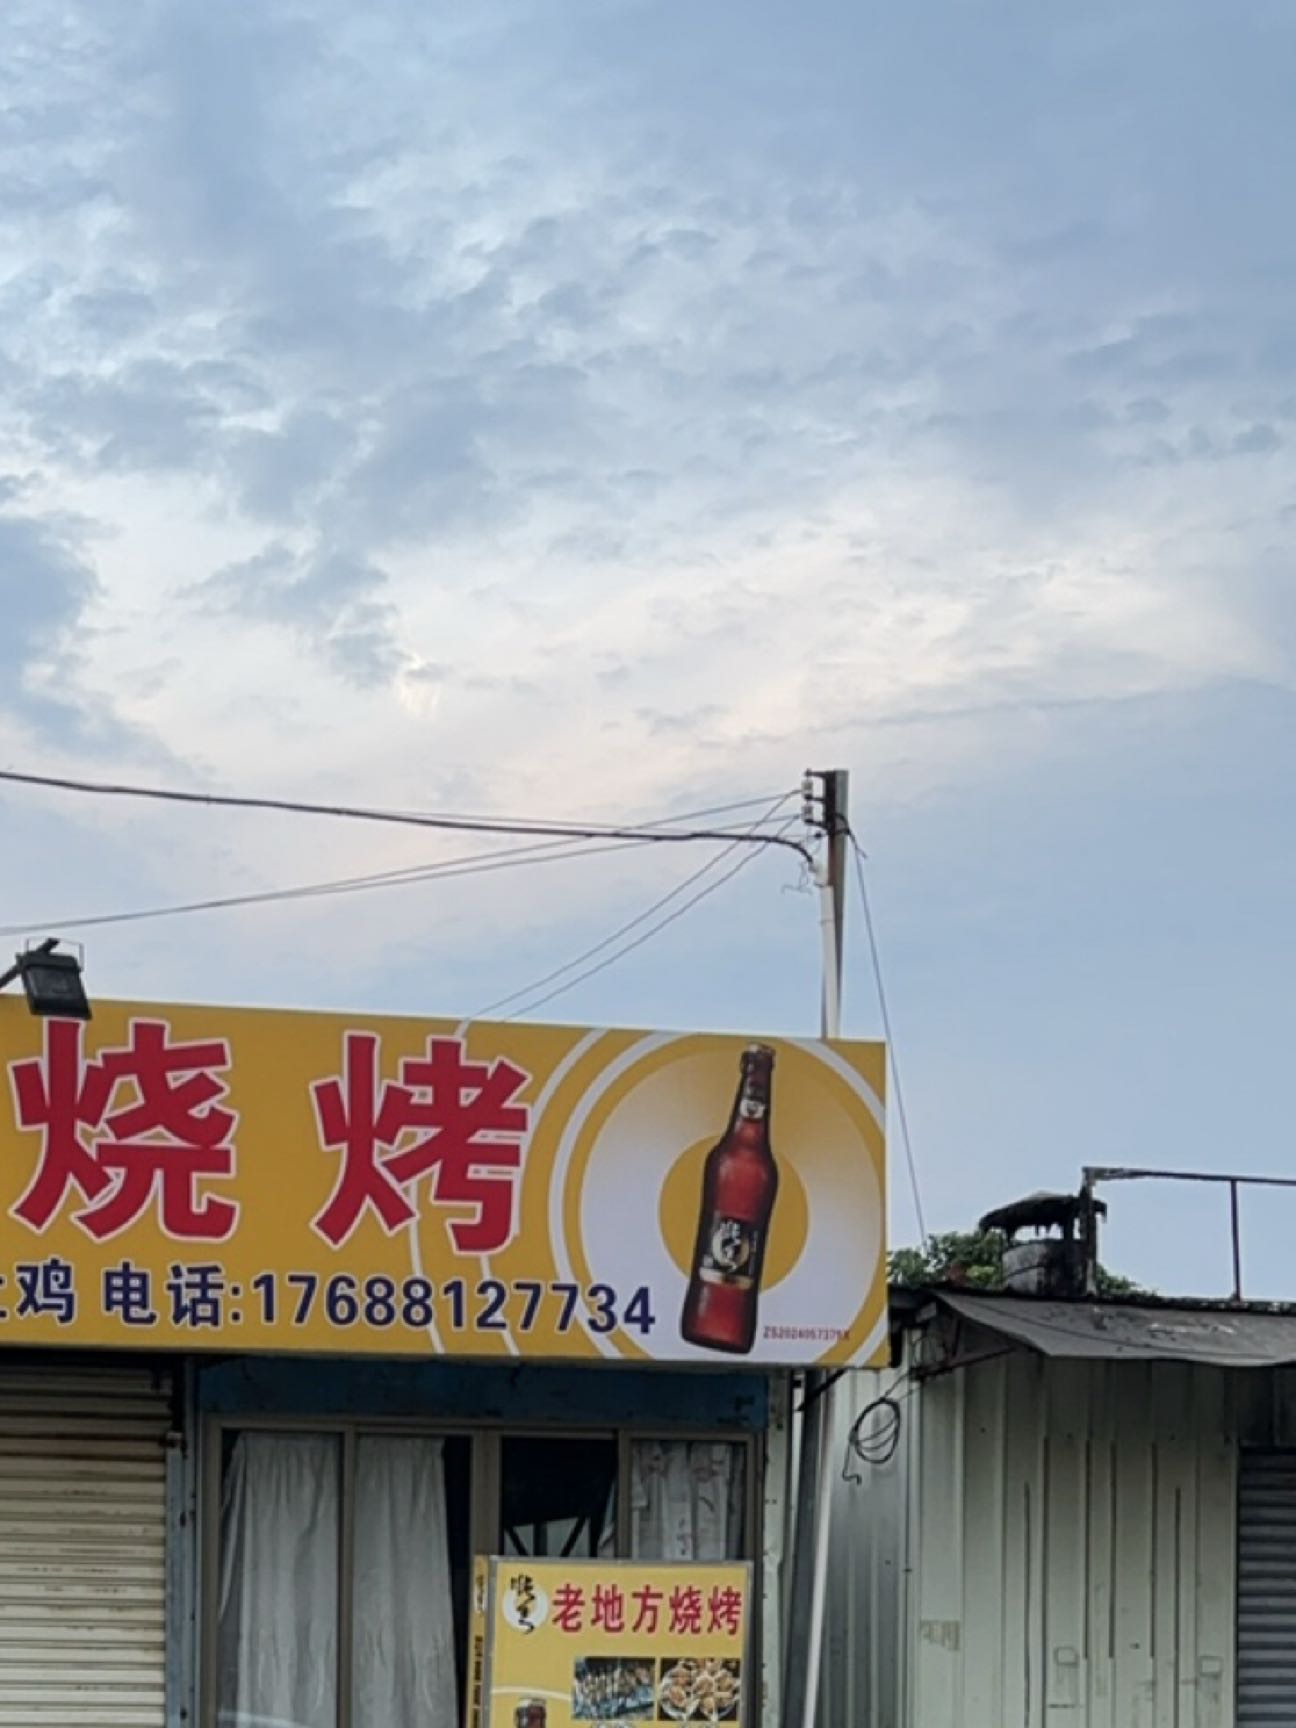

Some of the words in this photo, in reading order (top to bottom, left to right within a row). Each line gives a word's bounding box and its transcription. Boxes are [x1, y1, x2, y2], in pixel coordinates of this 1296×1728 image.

[552, 1582, 743, 1636] 老地方烧烤
